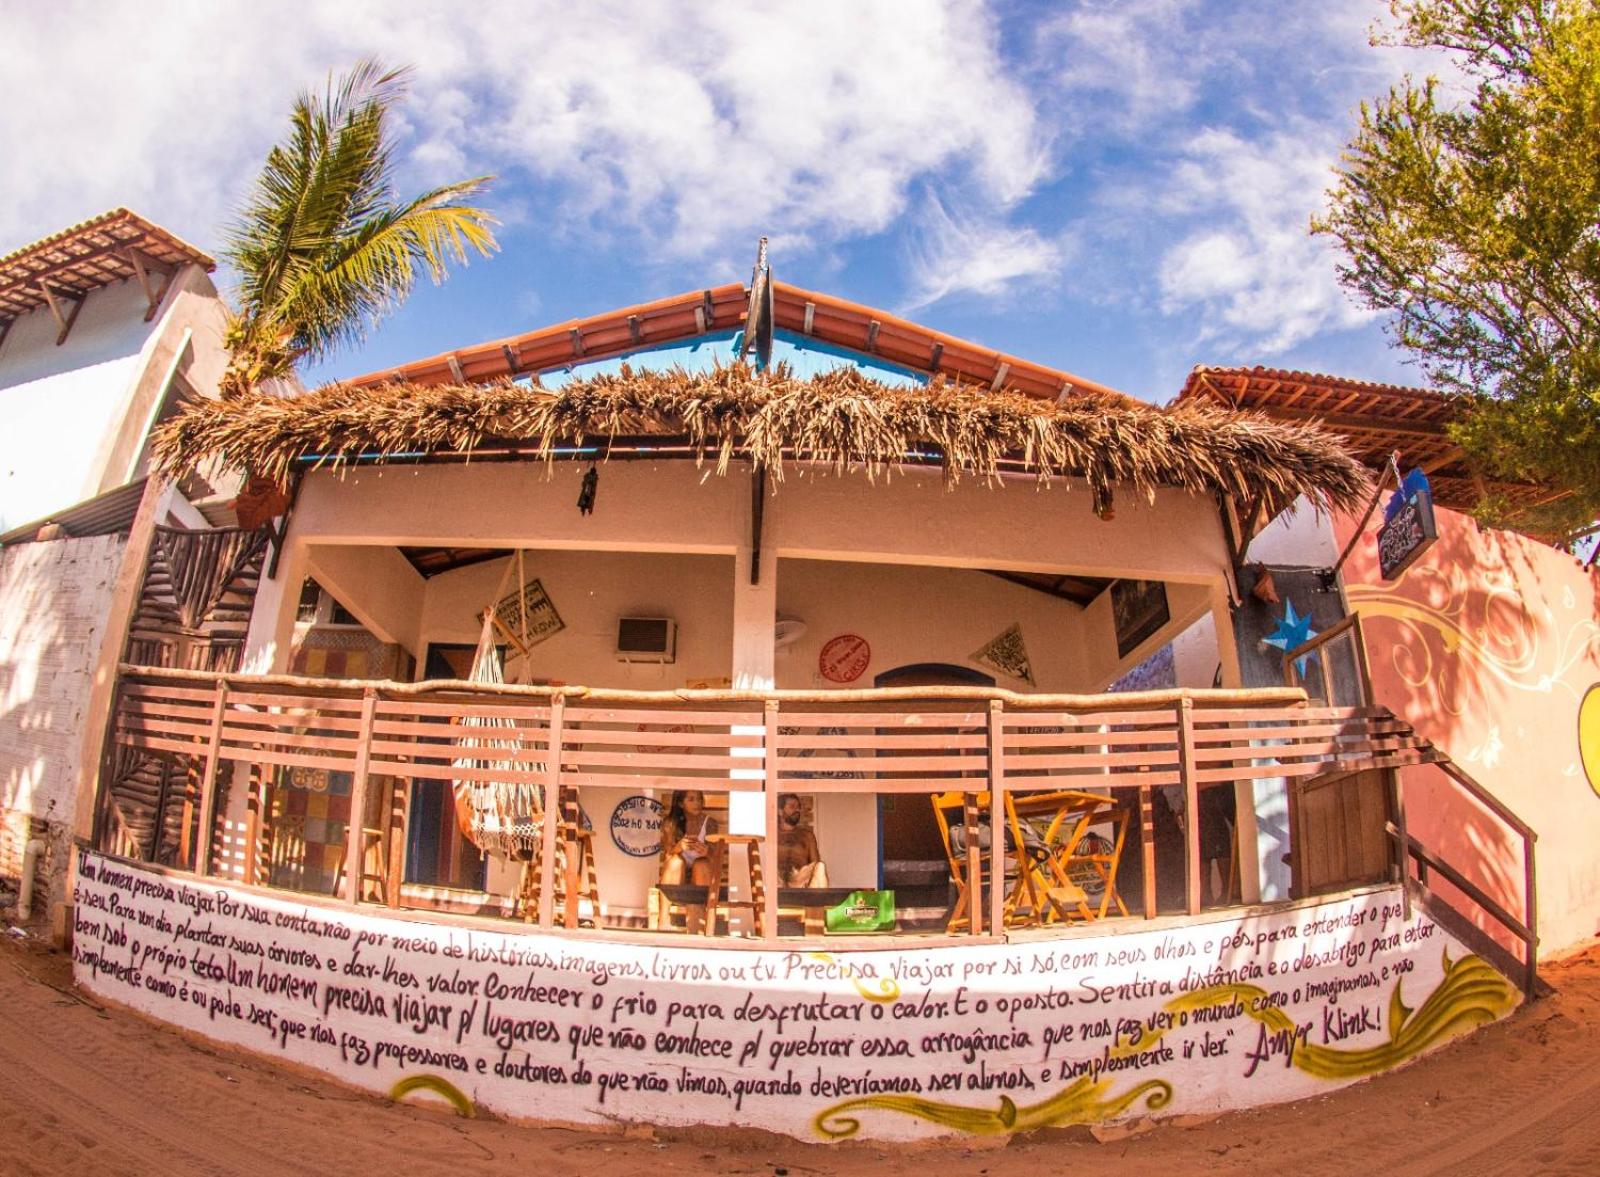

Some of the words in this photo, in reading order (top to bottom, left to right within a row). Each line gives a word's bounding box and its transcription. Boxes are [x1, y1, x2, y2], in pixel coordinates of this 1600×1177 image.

[75, 906, 100, 939] bem
[102, 922, 127, 947] sob
[131, 941, 140, 956] o
[256, 959, 318, 1008] homem
[324, 985, 388, 1018] precisa
[482, 1001, 560, 1049] lugares
[569, 1024, 604, 1060] que
[608, 1027, 647, 1050] não
[655, 1021, 733, 1058] conhece
[769, 1026, 853, 1071] quebrar
[861, 1038, 915, 1057] essa
[922, 1027, 1033, 1064] arrogância
[1043, 1023, 1073, 1063] que
[1080, 1019, 1111, 1041] nos
[1115, 1017, 1144, 1047] faz
[1147, 1011, 1176, 1031] ver
[1180, 1010, 1188, 1026] o
[1192, 993, 1244, 1024] mundo
[1251, 992, 1288, 1012] como
[1292, 986, 1300, 1002] o
[1381, 966, 1389, 980] e
[1392, 958, 1414, 976] não
[173, 918, 226, 948] plantar
[228, 935, 265, 957] suas
[327, 959, 337, 972] e
[343, 950, 420, 988] dar-lhes
[485, 971, 583, 1009] Conhecer
[592, 992, 603, 1010] o
[611, 991, 657, 1023] frio
[665, 1002, 725, 1027] para
[733, 991, 864, 1034] desfrutar
[871, 1003, 884, 1020] o
[892, 988, 949, 1019] calor.
[976, 1000, 988, 1014] o
[996, 985, 1074, 1022] oposto.
[1178, 958, 1263, 992] distância
[1268, 961, 1277, 976] e
[1280, 960, 1288, 975] o
[1293, 935, 1366, 970] desabrigo
[1369, 935, 1401, 963] para
[1404, 918, 1435, 943] estar
[217, 890, 239, 917] Por
[241, 903, 271, 926] sua
[352, 929, 387, 952] por
[392, 936, 438, 956] meio
[442, 931, 464, 959] de
[652, 952, 712, 981] livros
[718, 965, 746, 982] ou
[783, 951, 879, 982] Precisa
[963, 961, 997, 982] por
[1002, 956, 1023, 975] si
[1060, 951, 1099, 969] com
[1105, 947, 1147, 967] seus
[1154, 936, 1197, 961] olhos
[1203, 939, 1213, 954] e
[1256, 929, 1298, 955] para
[1302, 904, 1367, 937] entender
[1369, 906, 1377, 922] o
[1381, 903, 1402, 932] que
[145, 975, 177, 998] como
[179, 980, 188, 1001] é
[192, 989, 207, 1008] ou
[210, 989, 243, 1020] pode
[280, 1019, 307, 1049] que
[341, 1032, 371, 1066] faz
[373, 1041, 469, 1073] professores
[475, 1058, 487, 1074] e
[494, 1052, 567, 1084] doutores
[571, 1058, 592, 1085] do
[598, 1072, 630, 1104] que
[632, 1071, 668, 1093] não
[733, 1069, 802, 1111] quando
[810, 1066, 922, 1097] deveríamos
[927, 1072, 963, 1091] ser
[1041, 1068, 1051, 1083] e
[1183, 1039, 1195, 1060] ir
[1243, 1021, 1313, 1078] Amyr
[1323, 1005, 1382, 1045] Klink!
